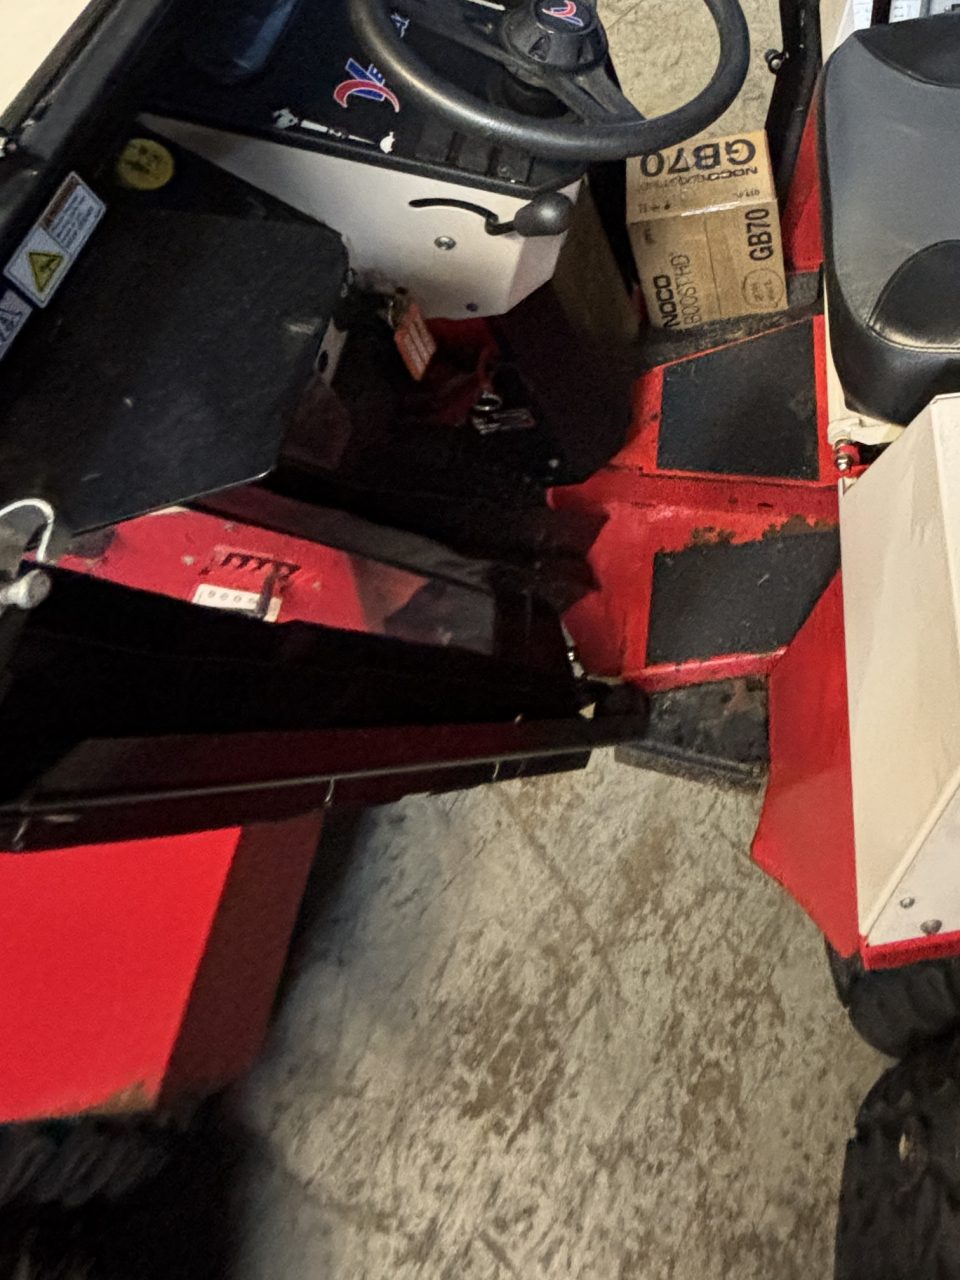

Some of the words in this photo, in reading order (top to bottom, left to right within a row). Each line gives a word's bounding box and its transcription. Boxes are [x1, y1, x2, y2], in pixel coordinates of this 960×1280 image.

[640, 138, 756, 177] GB70
[744, 208, 774, 261] GB70
[653, 274, 680, 328] NOCO
